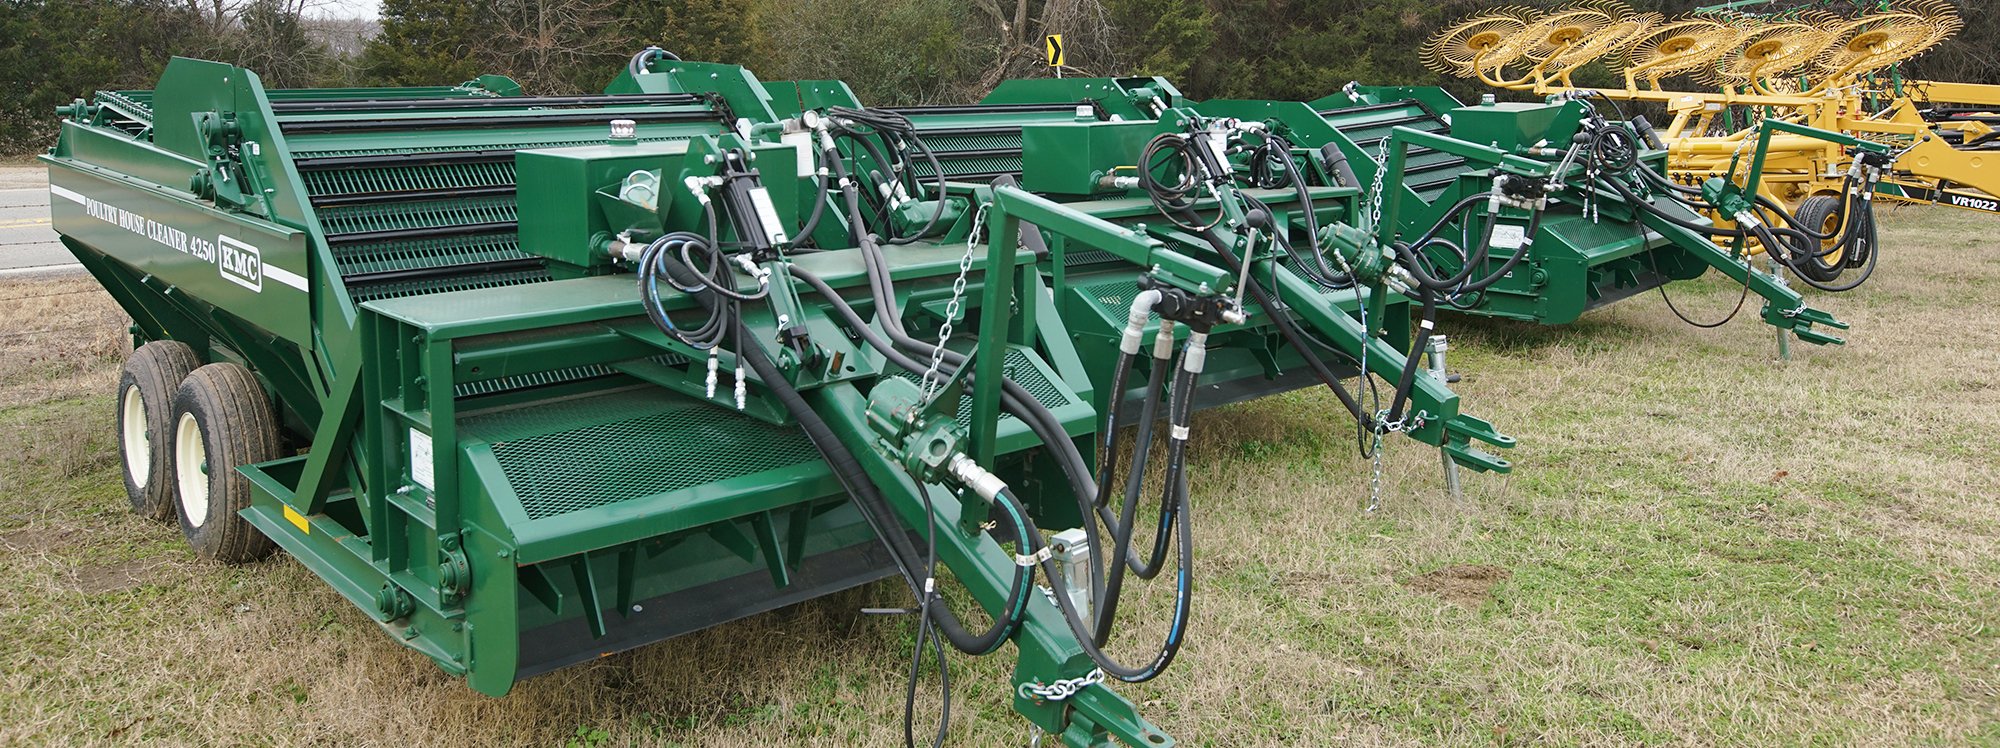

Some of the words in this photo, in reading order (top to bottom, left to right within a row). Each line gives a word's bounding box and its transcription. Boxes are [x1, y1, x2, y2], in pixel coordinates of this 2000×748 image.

[1952, 195, 1997, 211] VR1022
[86, 198, 118, 225] POULTRY
[119, 208, 145, 236] HOUSE
[147, 219, 188, 253] CLEANER
[190, 236, 215, 264] 4250
[222, 245, 257, 281] KMC
